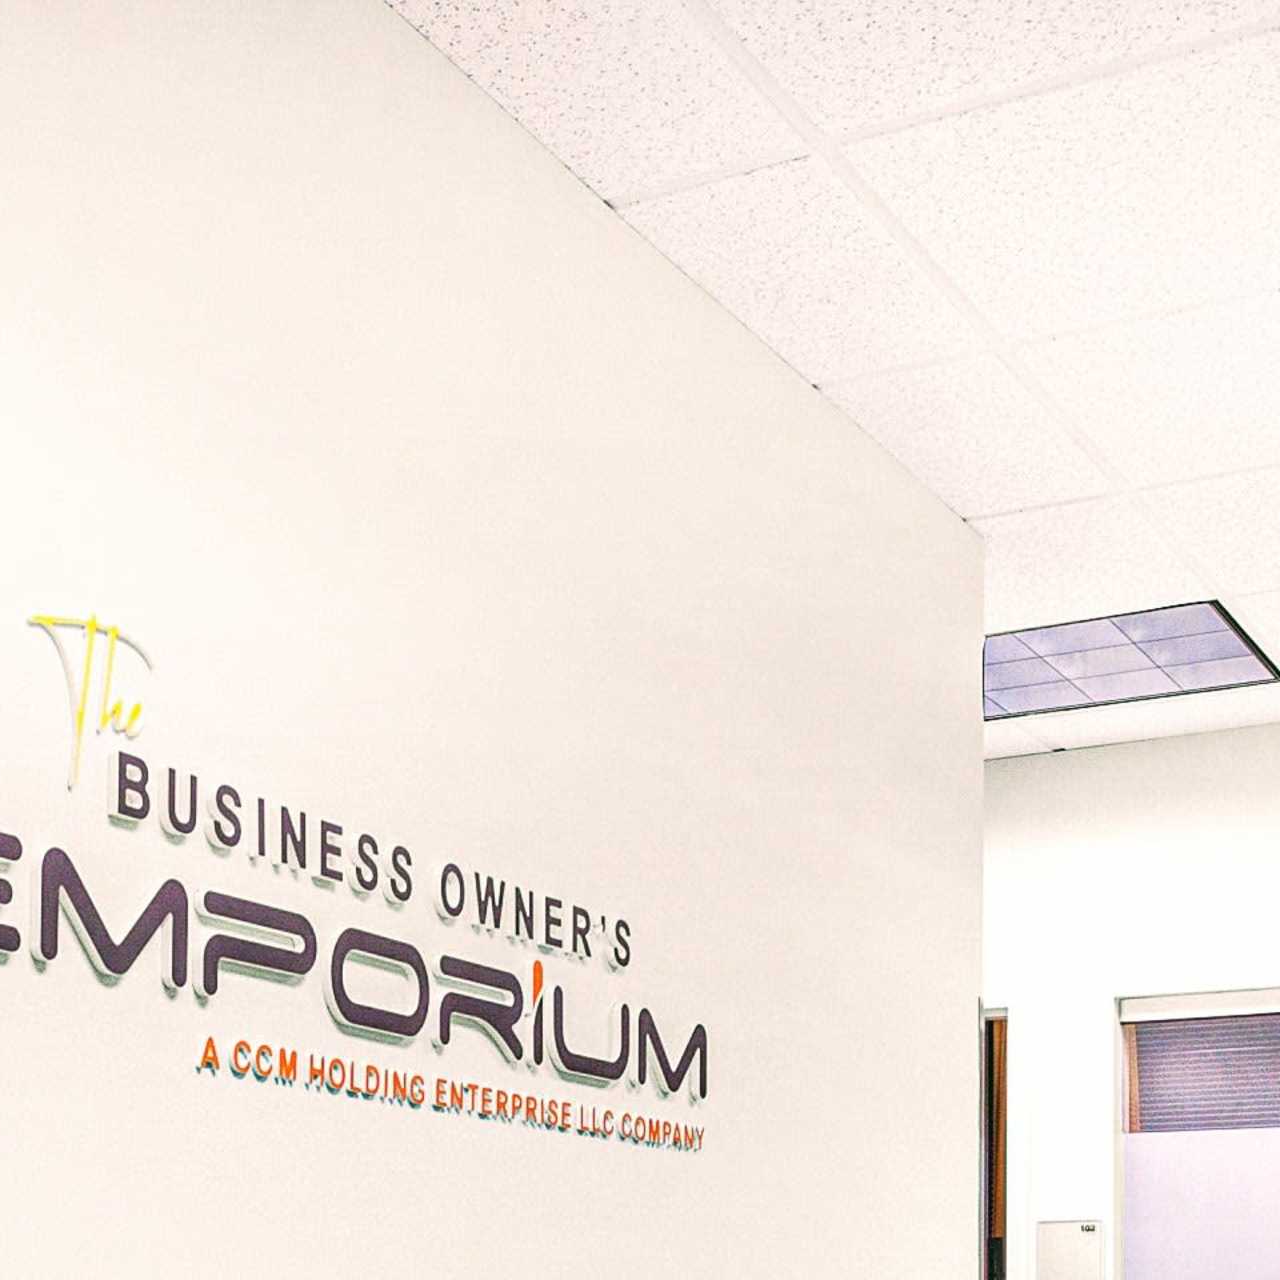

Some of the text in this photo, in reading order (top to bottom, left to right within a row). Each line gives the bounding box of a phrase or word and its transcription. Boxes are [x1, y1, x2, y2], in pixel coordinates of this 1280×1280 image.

[27, 614, 154, 792] The
[116, 750, 632, 968] BUSINESS OWNER'S
[200, 1036, 706, 1151] A CCM HOLDING ENTERPRISE LLC COMPANY
